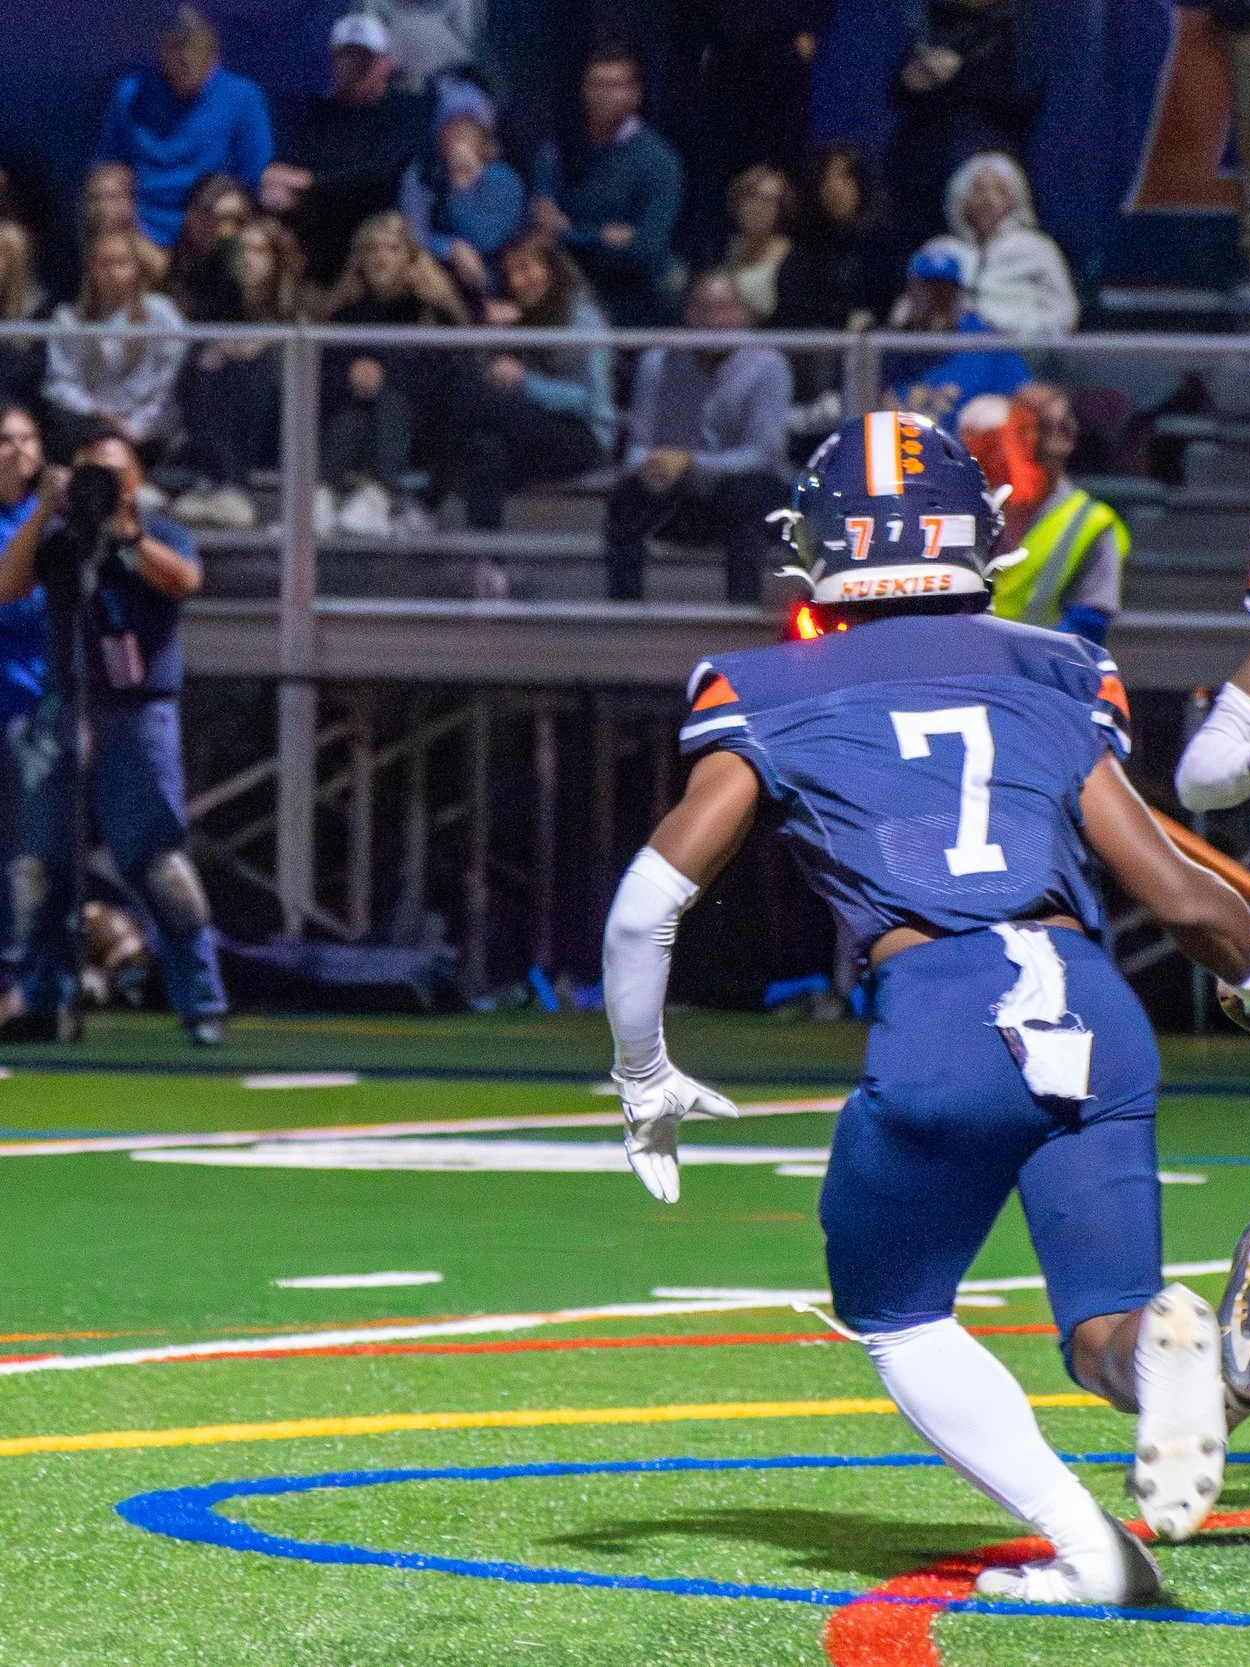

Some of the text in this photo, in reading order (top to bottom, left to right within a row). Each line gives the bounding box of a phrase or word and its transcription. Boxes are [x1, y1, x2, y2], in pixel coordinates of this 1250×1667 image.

[845, 517, 875, 560] 7
[919, 515, 945, 559] 7
[840, 574, 952, 599] HUSKIES
[889, 705, 1008, 877] 7
